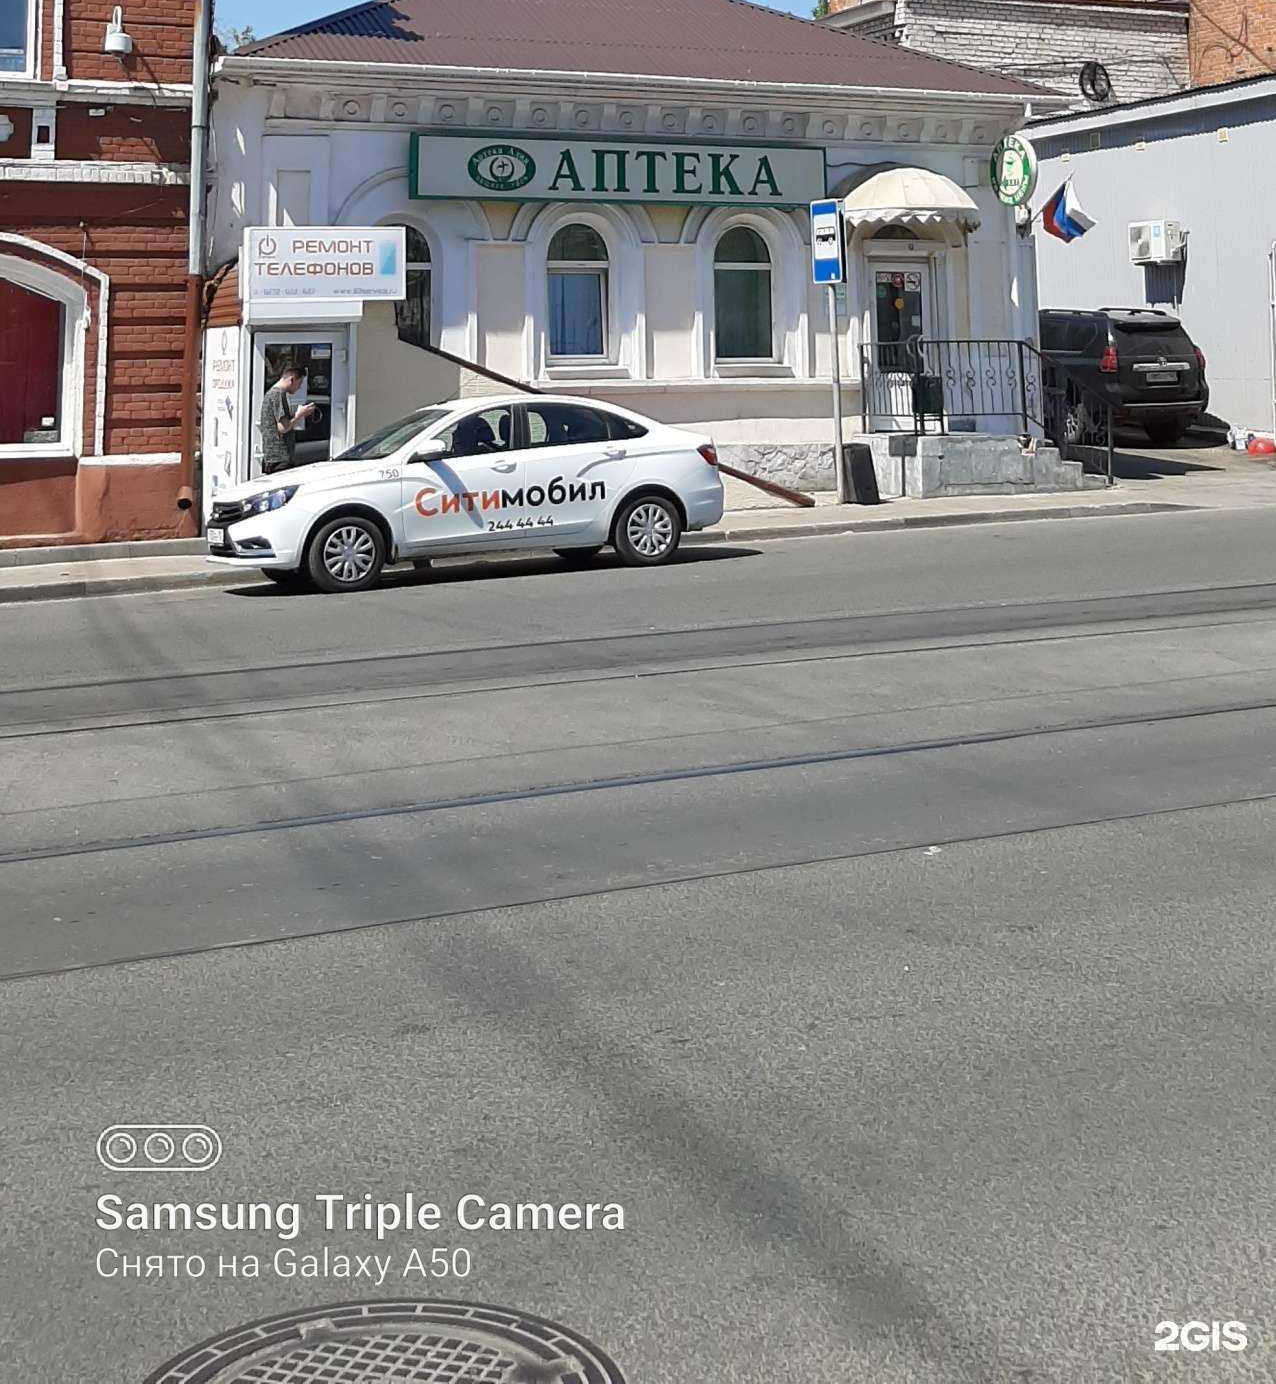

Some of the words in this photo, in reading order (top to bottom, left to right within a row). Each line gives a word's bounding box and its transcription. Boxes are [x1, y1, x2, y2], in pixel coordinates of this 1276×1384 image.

[548, 148, 783, 197] АПТЕКА
[292, 239, 374, 254] РЕМОНТ
[254, 262, 374, 276] ТЕЛЕФОНОВ
[378, 468, 400, 480] 750
[415, 475, 607, 517] Ситимобил
[488, 519, 513, 532] 244
[516, 516, 534, 528] 44
[537, 515, 554, 527] 44
